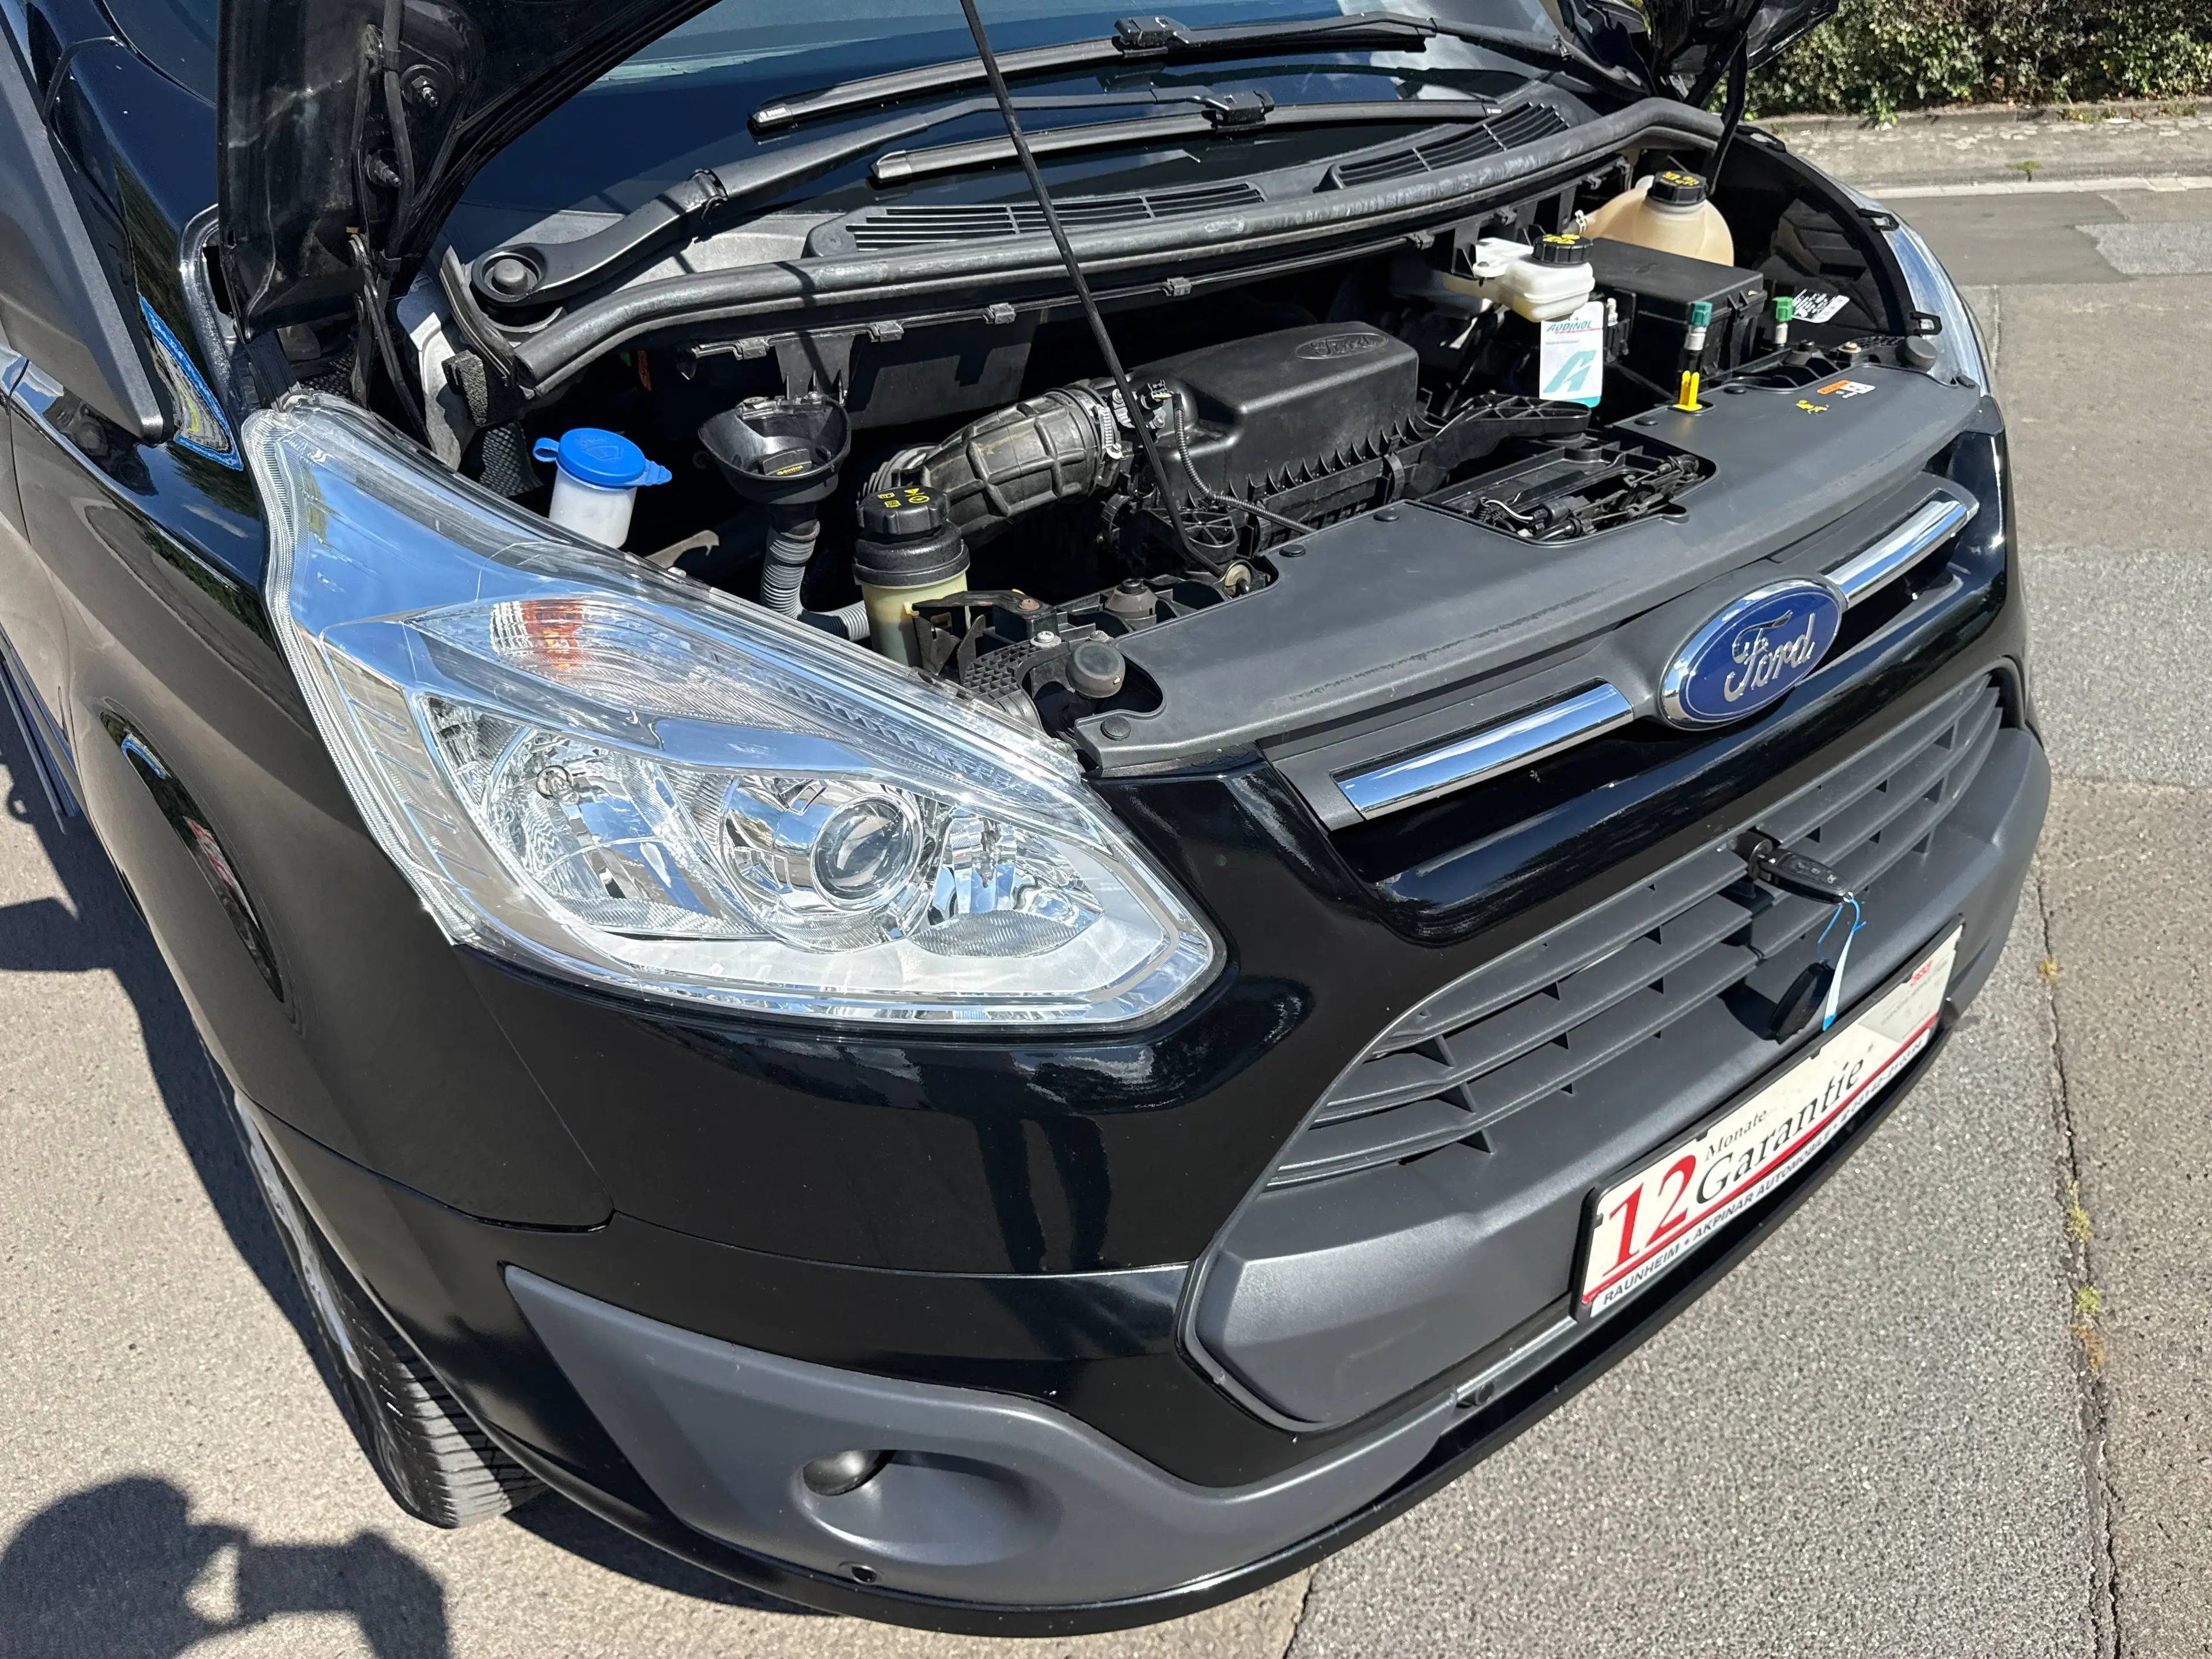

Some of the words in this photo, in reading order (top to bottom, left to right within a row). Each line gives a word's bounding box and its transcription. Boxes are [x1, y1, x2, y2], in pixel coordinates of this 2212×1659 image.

[1309, 335, 1376, 357] Ford
[1724, 609, 1815, 702] Ford
[1602, 1154, 1696, 1277] 12
[1696, 1058, 1864, 1205] Garantie
[1705, 1109, 1767, 1162] Monate
[1603, 1243, 1681, 1305] RAUNHEIM
[1694, 1192, 1754, 1240] AKPINAR
[1756, 1130, 1831, 1196] AUTOMOBILE
